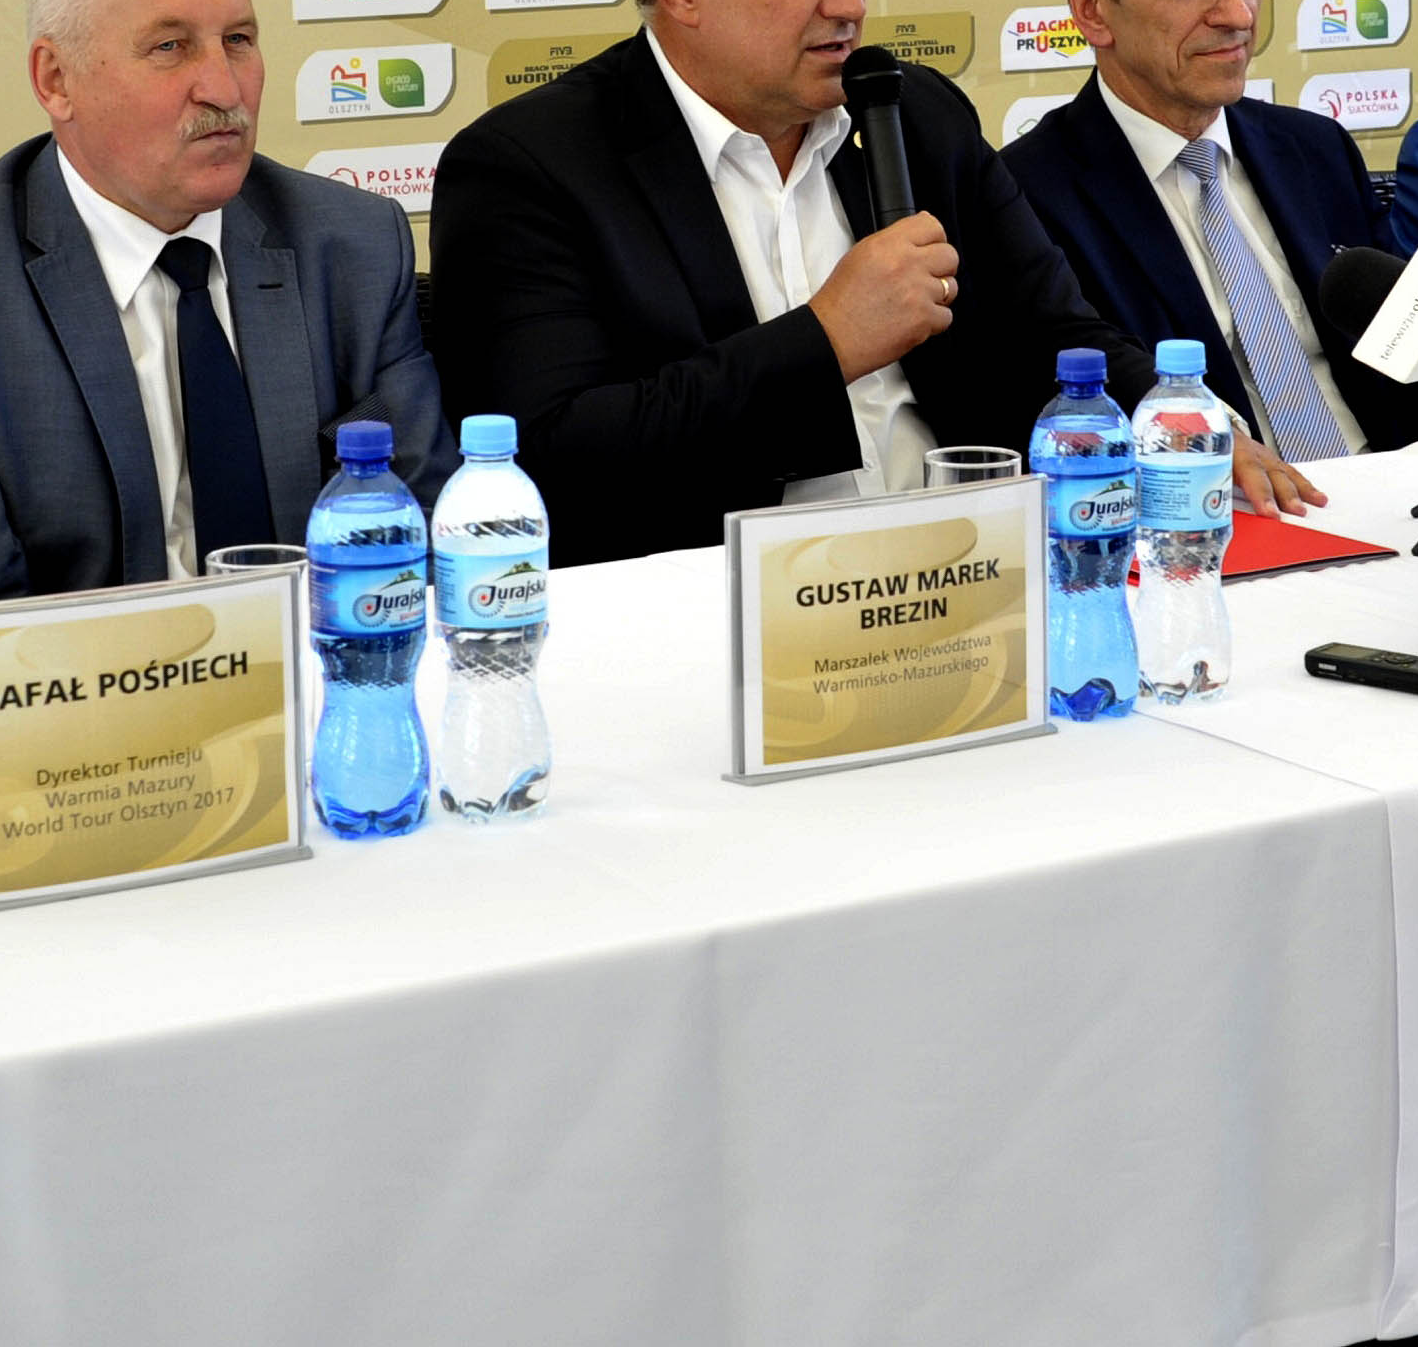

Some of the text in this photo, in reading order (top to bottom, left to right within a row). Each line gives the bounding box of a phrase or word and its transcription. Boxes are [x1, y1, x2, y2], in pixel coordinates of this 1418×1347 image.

[917, 45, 955, 55] TOUR
[329, 103, 370, 114] OLSZTYN
[1346, 89, 1398, 102] POLSKA
[796, 558, 999, 607] GUSTAW MAREK
[861, 597, 948, 630] BREZIN
[99, 651, 248, 699] POŚPIECH
[814, 655, 989, 694] Warmińsko-Mazurskiego
[37, 747, 203, 788] Dyrektor Turnieju
[45, 772, 196, 809] Warmia Mazury
[3, 787, 234, 839] World Tour Olsztyn 2017
